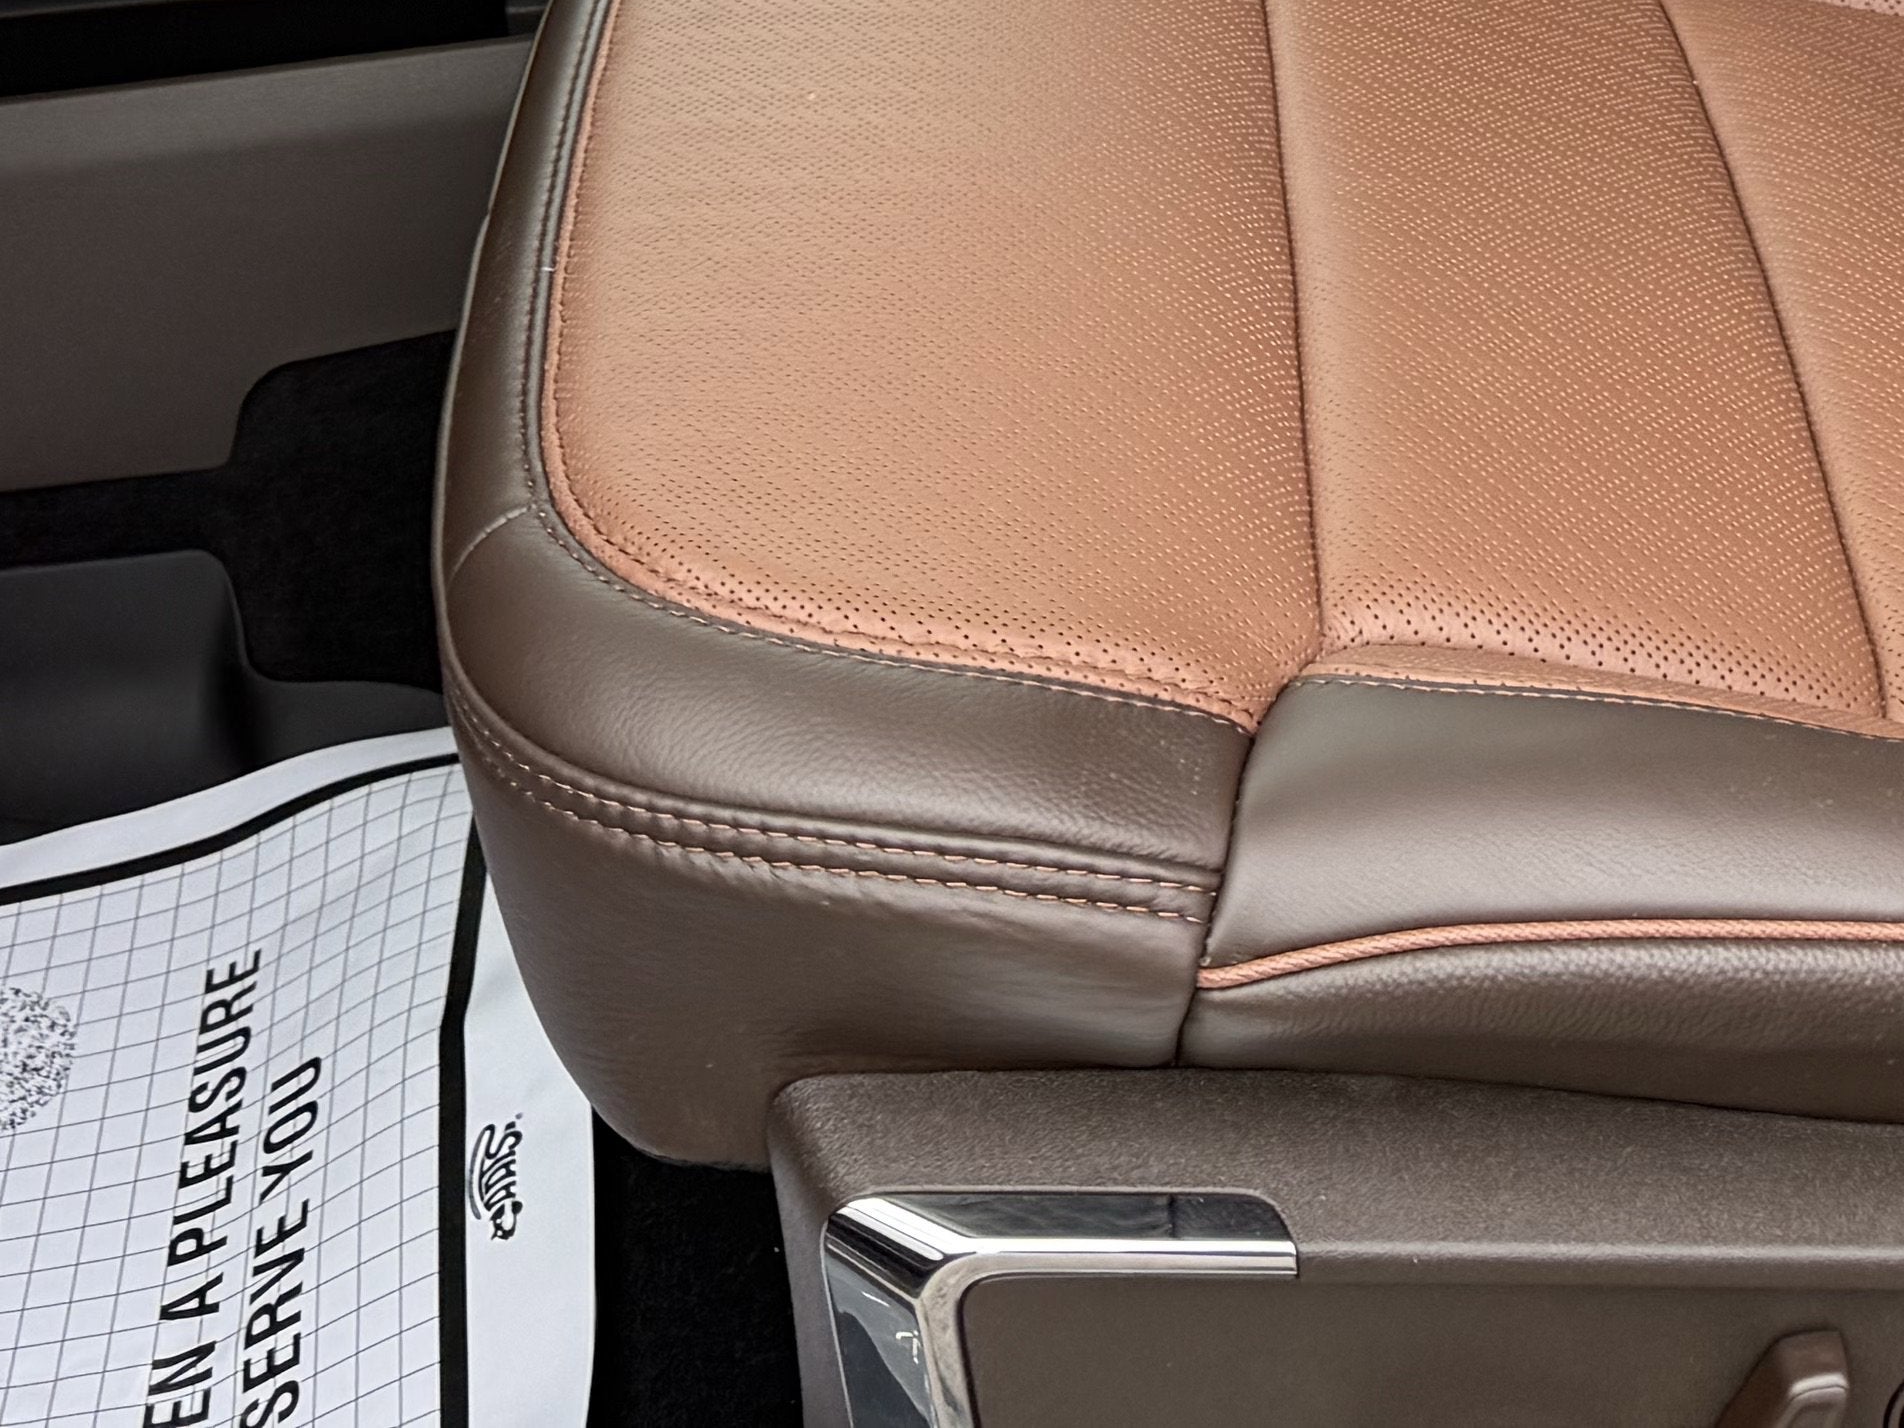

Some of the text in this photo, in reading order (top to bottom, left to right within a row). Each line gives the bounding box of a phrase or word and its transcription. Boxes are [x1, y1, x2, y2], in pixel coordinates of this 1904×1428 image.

[142, 947, 262, 1428] EN A PLEASURE
[238, 1056, 323, 1428] SERVE YOU
